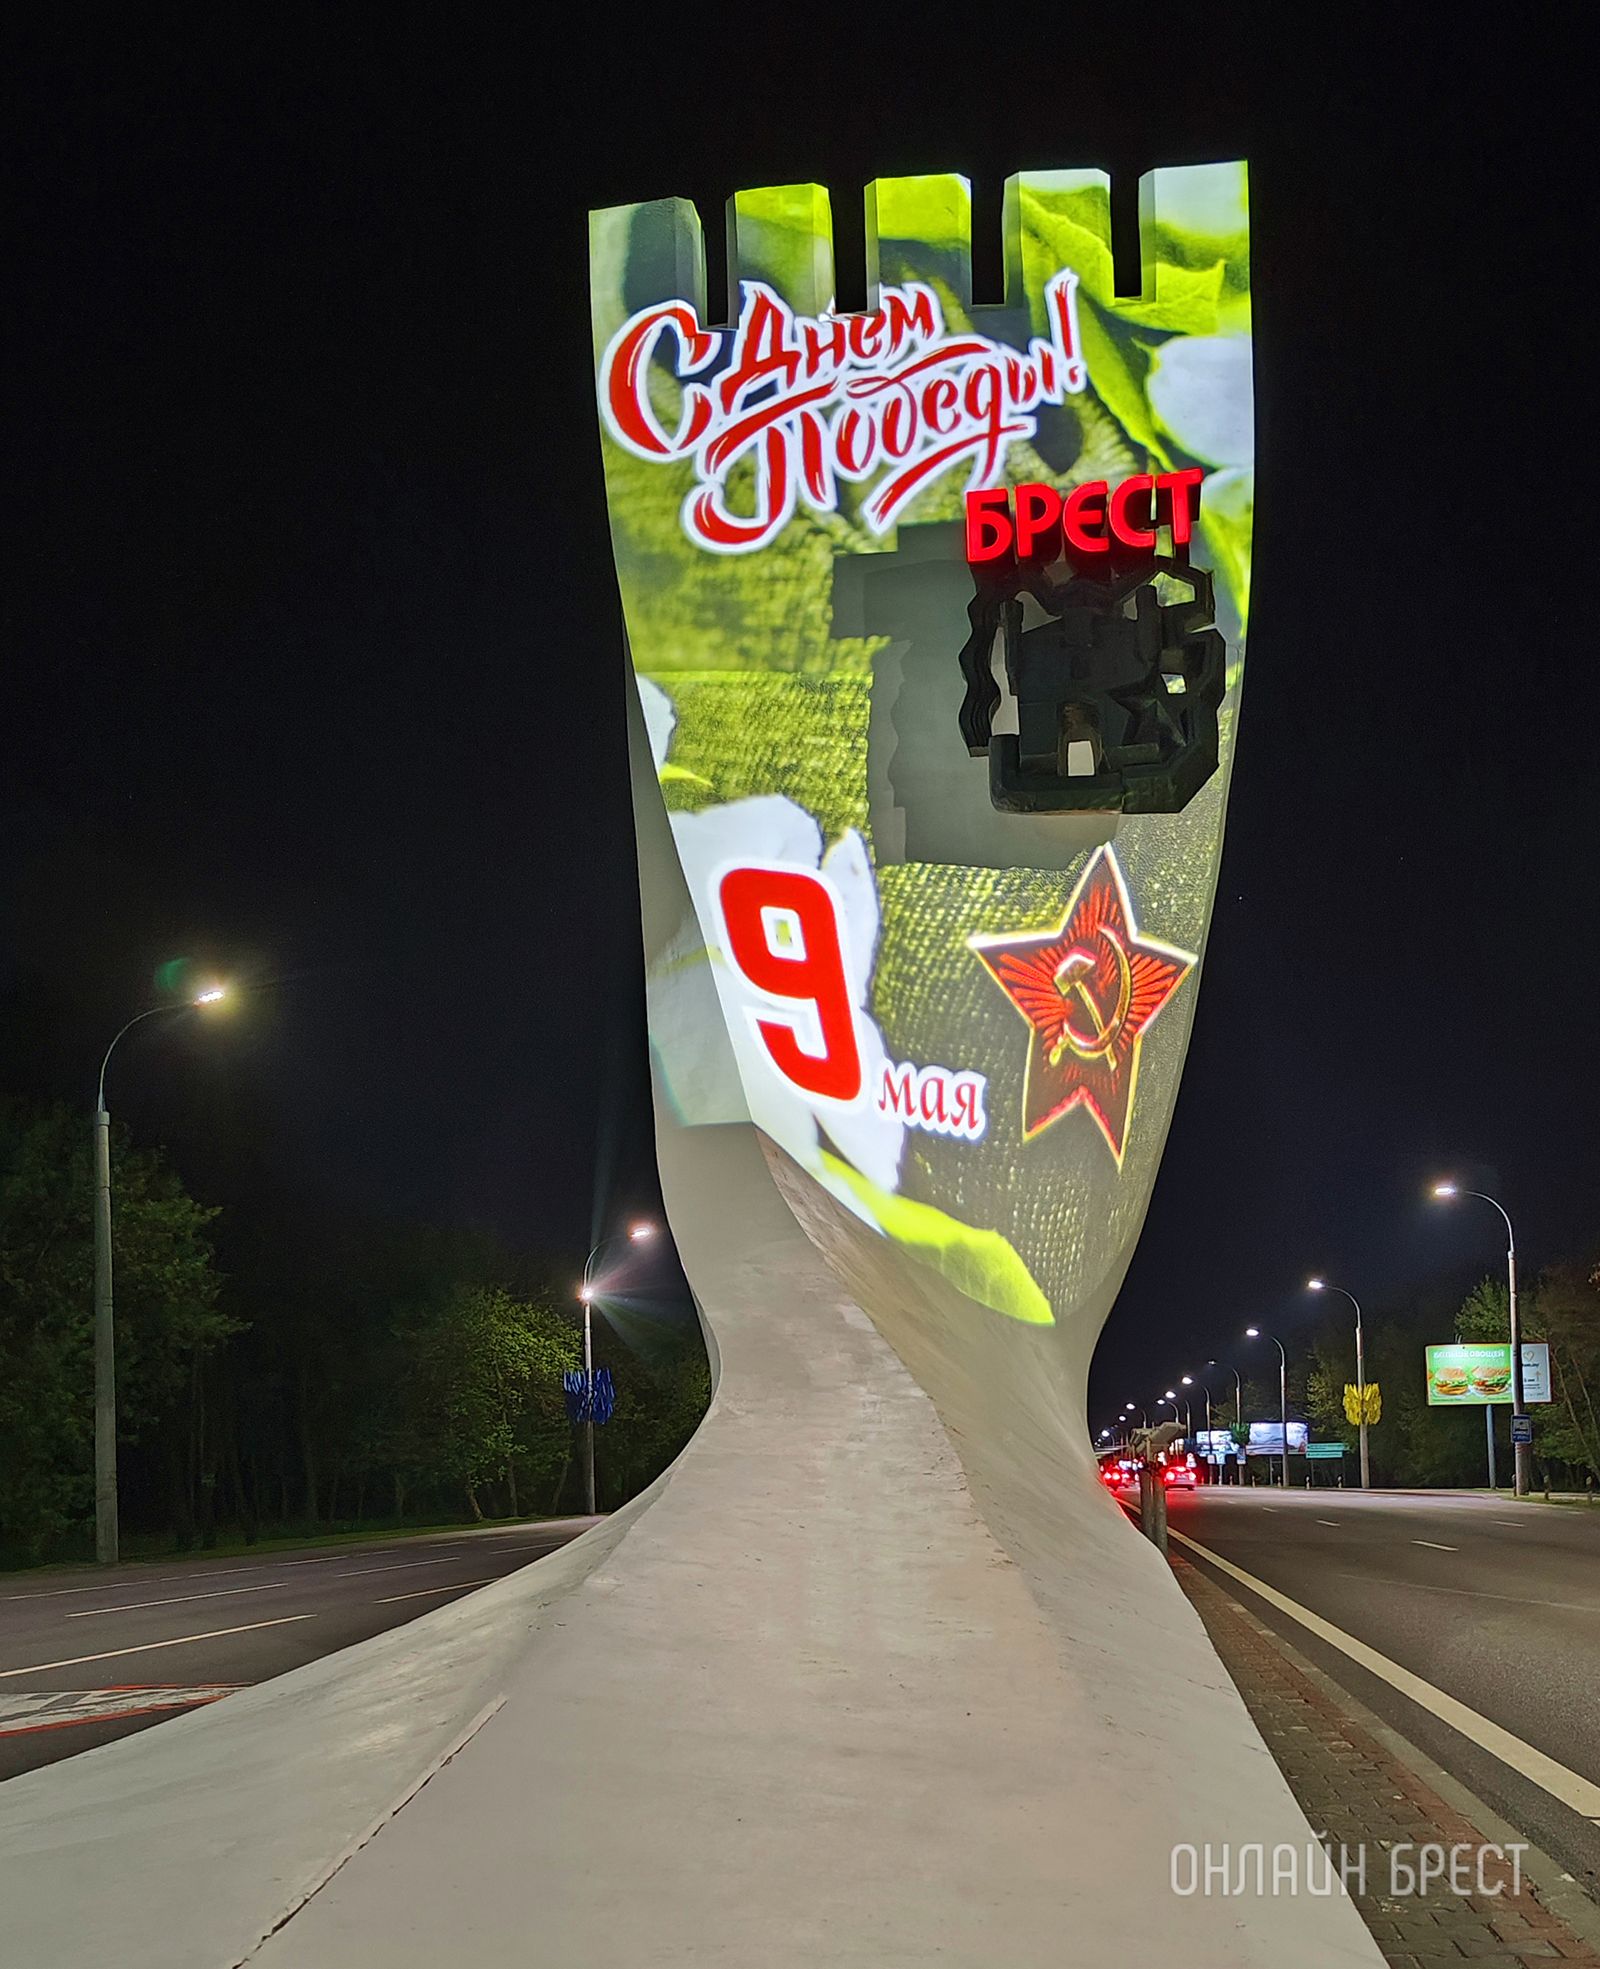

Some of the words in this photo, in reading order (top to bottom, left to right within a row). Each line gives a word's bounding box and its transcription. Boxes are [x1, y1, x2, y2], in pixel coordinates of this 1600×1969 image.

[603, 301, 719, 459] С
[718, 283, 940, 414] Днем
[690, 271, 1084, 549] Победы!
[965, 467, 1204, 564] БРЕСТ
[715, 863, 866, 1106] 9
[877, 1062, 983, 1134] мая
